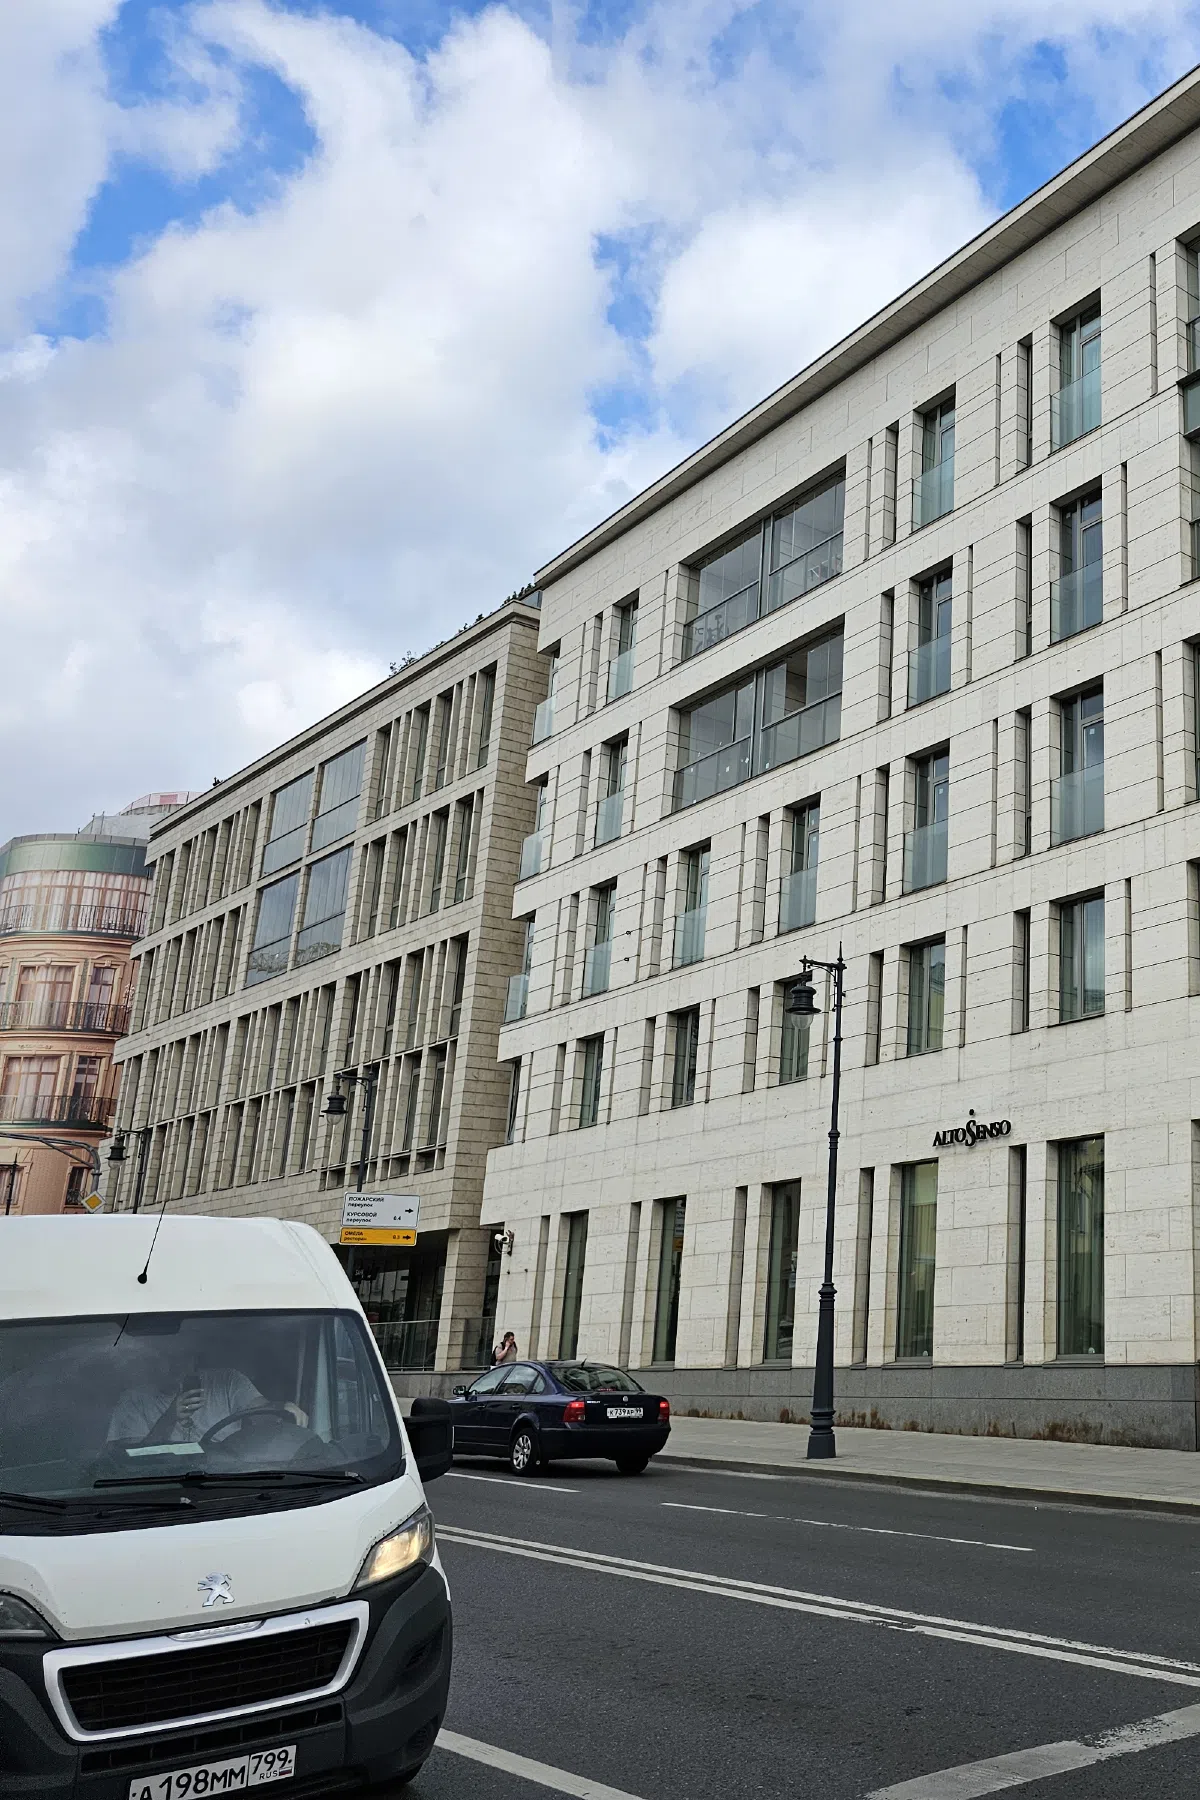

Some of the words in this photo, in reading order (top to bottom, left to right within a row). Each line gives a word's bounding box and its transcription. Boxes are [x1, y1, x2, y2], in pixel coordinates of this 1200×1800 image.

[932, 1119, 1012, 1147] ALTOSENSO
[251, 1749, 289, 1775] 799
[259, 1770, 278, 1780] RUS
